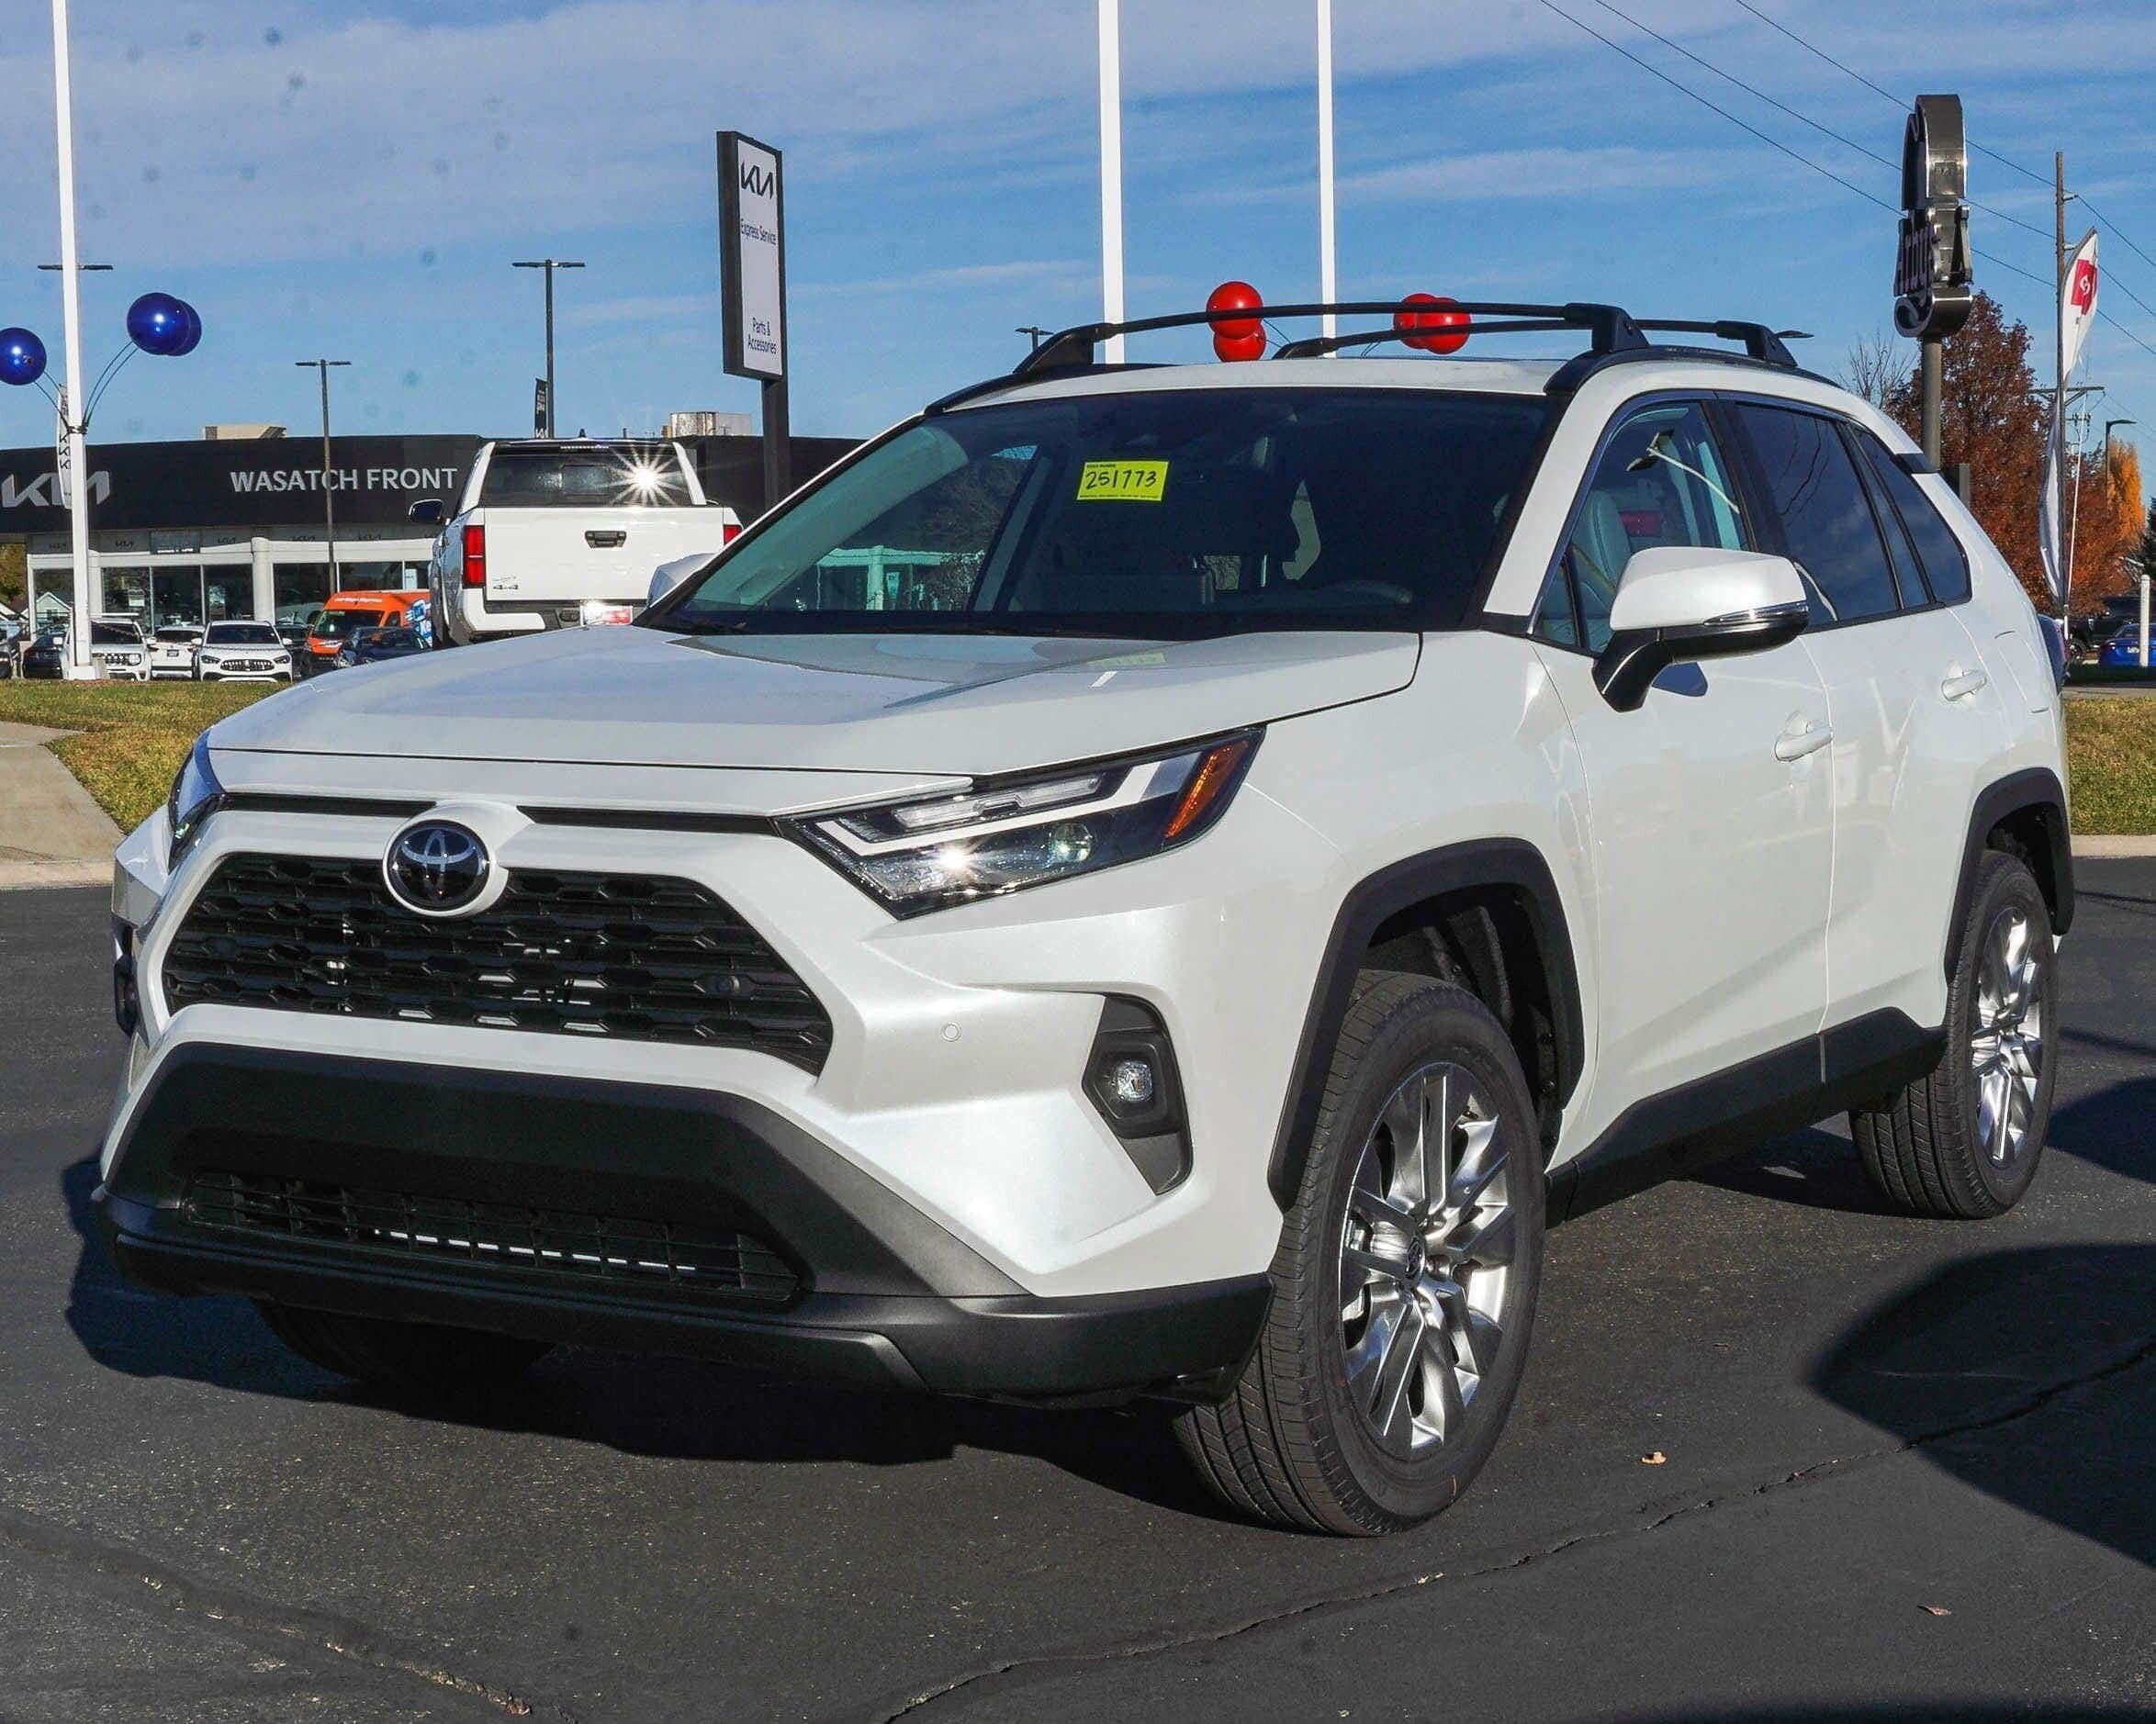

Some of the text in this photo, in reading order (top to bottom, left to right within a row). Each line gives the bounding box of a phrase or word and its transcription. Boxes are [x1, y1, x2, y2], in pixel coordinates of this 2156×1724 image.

[740, 161, 774, 199] KIA
[740, 218, 777, 246] Express Service
[230, 467, 457, 492] WASATCH FRONT
[1085, 469, 1157, 490] 251773
